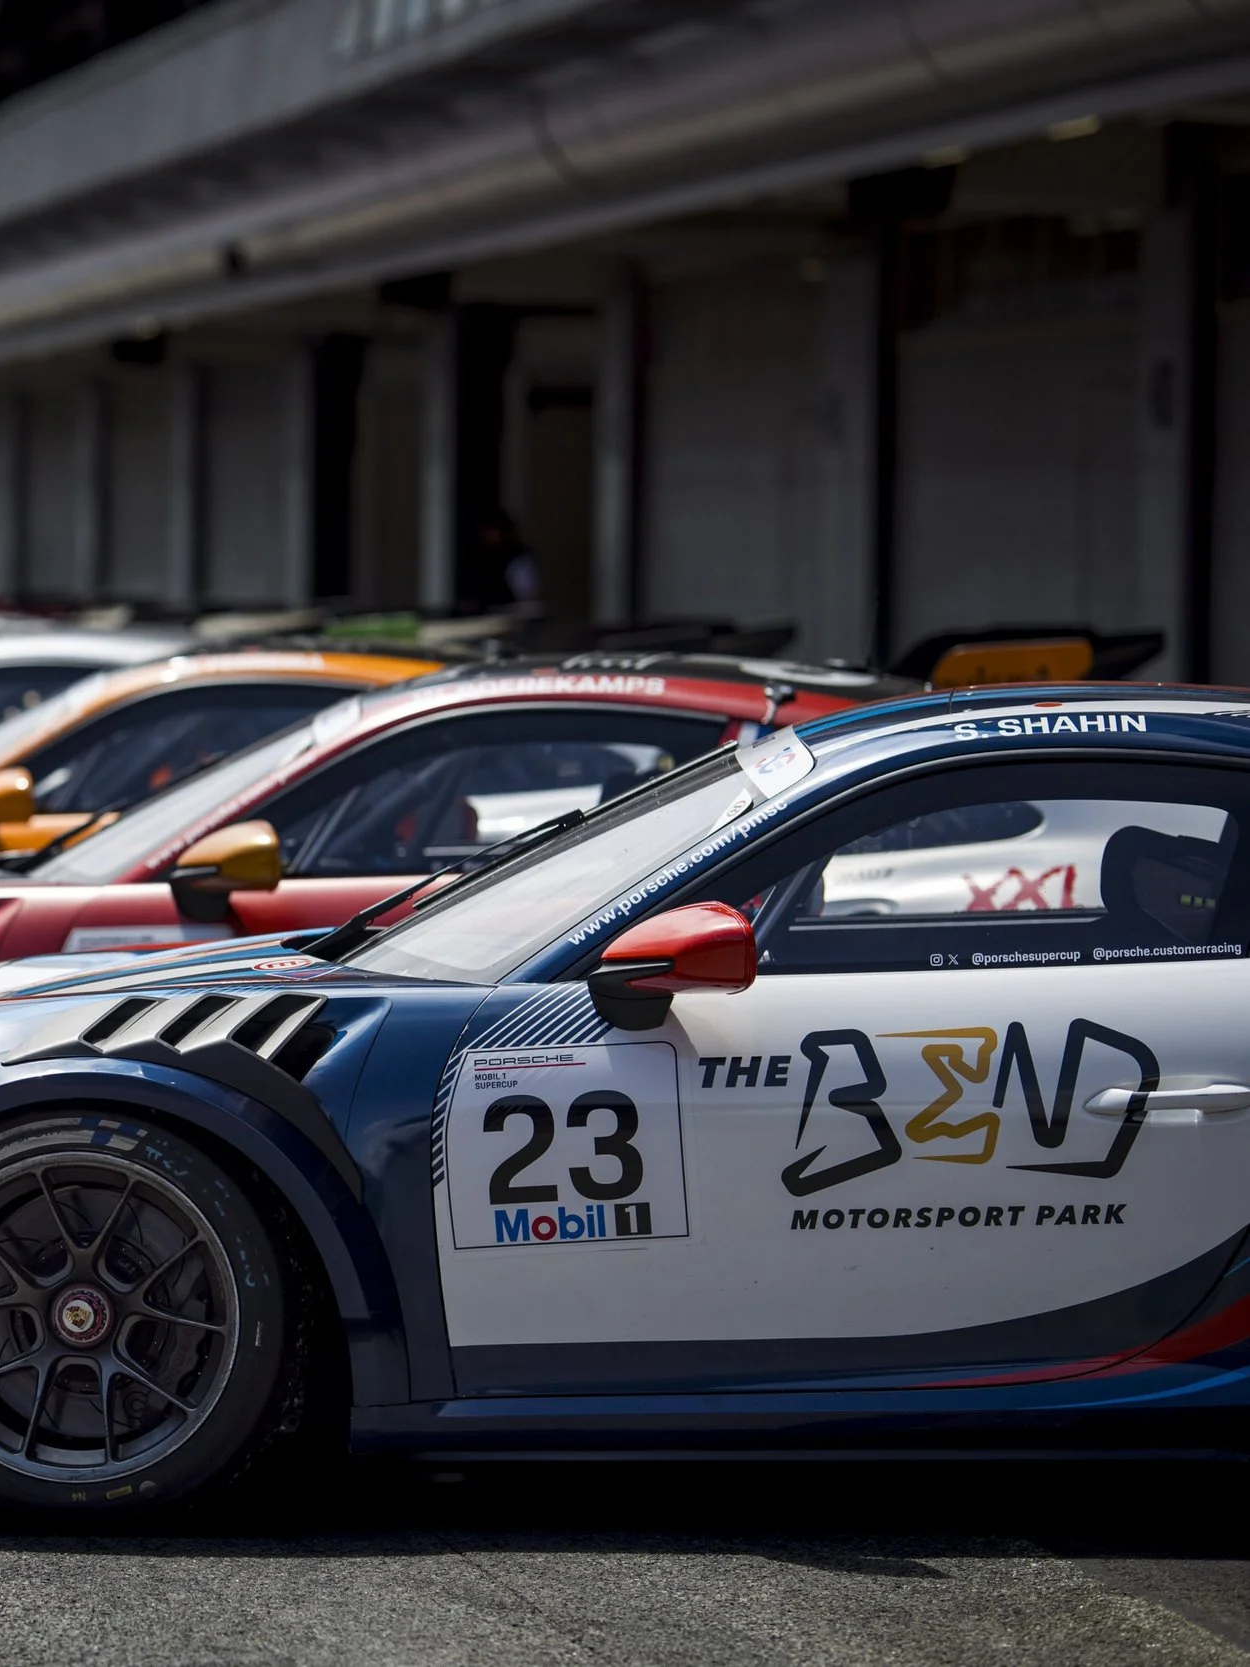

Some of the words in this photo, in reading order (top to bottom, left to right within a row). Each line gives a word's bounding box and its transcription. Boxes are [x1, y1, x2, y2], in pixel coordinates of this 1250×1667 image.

[953, 722, 989, 741] S.
[998, 714, 1147, 737] SHAHIN
[567, 800, 788, 946] www.porsche.com/pmsc
[971, 950, 1081, 965] @porschesupercup
[1093, 942, 1242, 960] @porsche.customerracing
[474, 1054, 573, 1066] PORSCHE
[698, 1055, 792, 1088] THE
[475, 1073, 500, 1081] MOBIL
[475, 1081, 518, 1089] SUPERCUP
[483, 1089, 644, 1205] 23
[494, 1204, 607, 1243] Mobil
[791, 1205, 1025, 1230] MOTORSPORT
[1036, 1203, 1127, 1226] PARK
